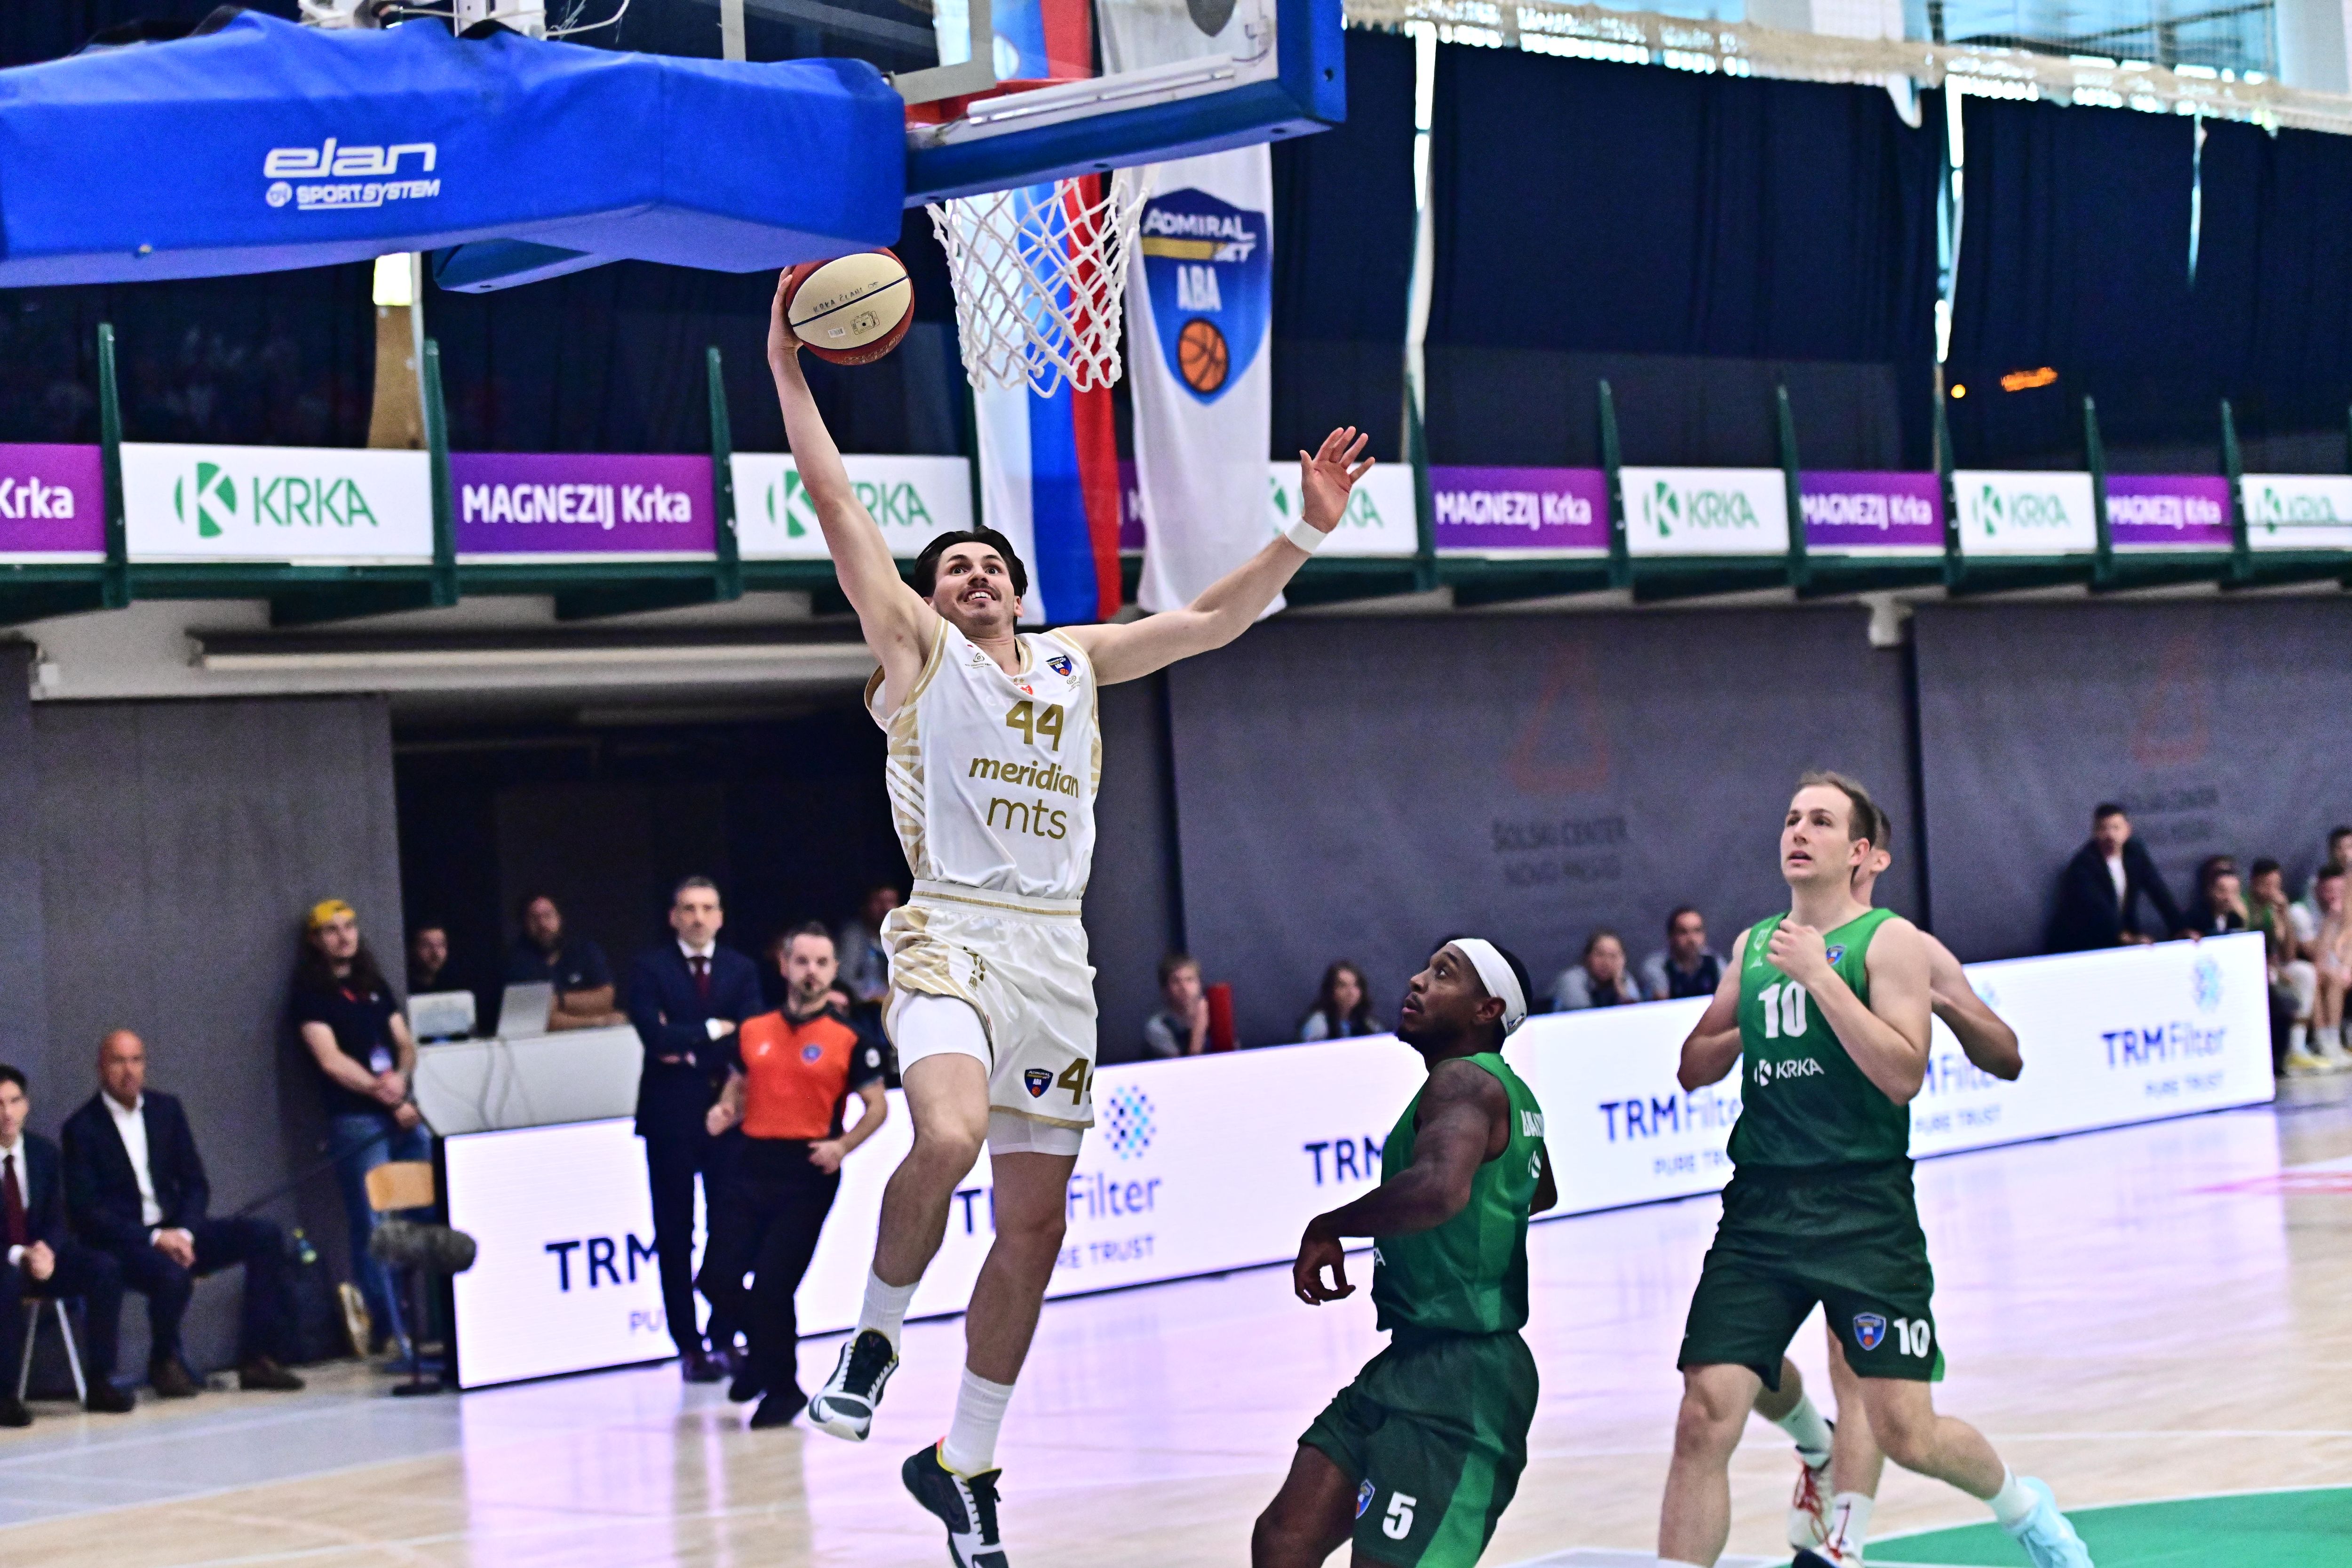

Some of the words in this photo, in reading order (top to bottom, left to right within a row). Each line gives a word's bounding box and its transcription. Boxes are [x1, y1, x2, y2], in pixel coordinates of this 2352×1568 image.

[263, 137, 437, 178] elan
[1142, 207, 1256, 241] ADMIRAL
[253, 476, 378, 527] KRKA
[462, 484, 614, 530] MAGNEZIJ
[621, 484, 692, 523] Krka
[850, 481, 933, 526] RKA
[1435, 491, 1541, 531] MAGNEZIJ
[1542, 492, 1593, 526] Krka
[1686, 488, 1759, 529] KRKA
[1006, 700, 1064, 752] 44
[969, 757, 1079, 799] meridian
[987, 797, 1067, 840] mts
[1758, 981, 1807, 1039] 10
[1776, 1058, 1825, 1080] KRKA
[1894, 1318, 1931, 1358] 10
[1382, 1491, 1417, 1540] 5
